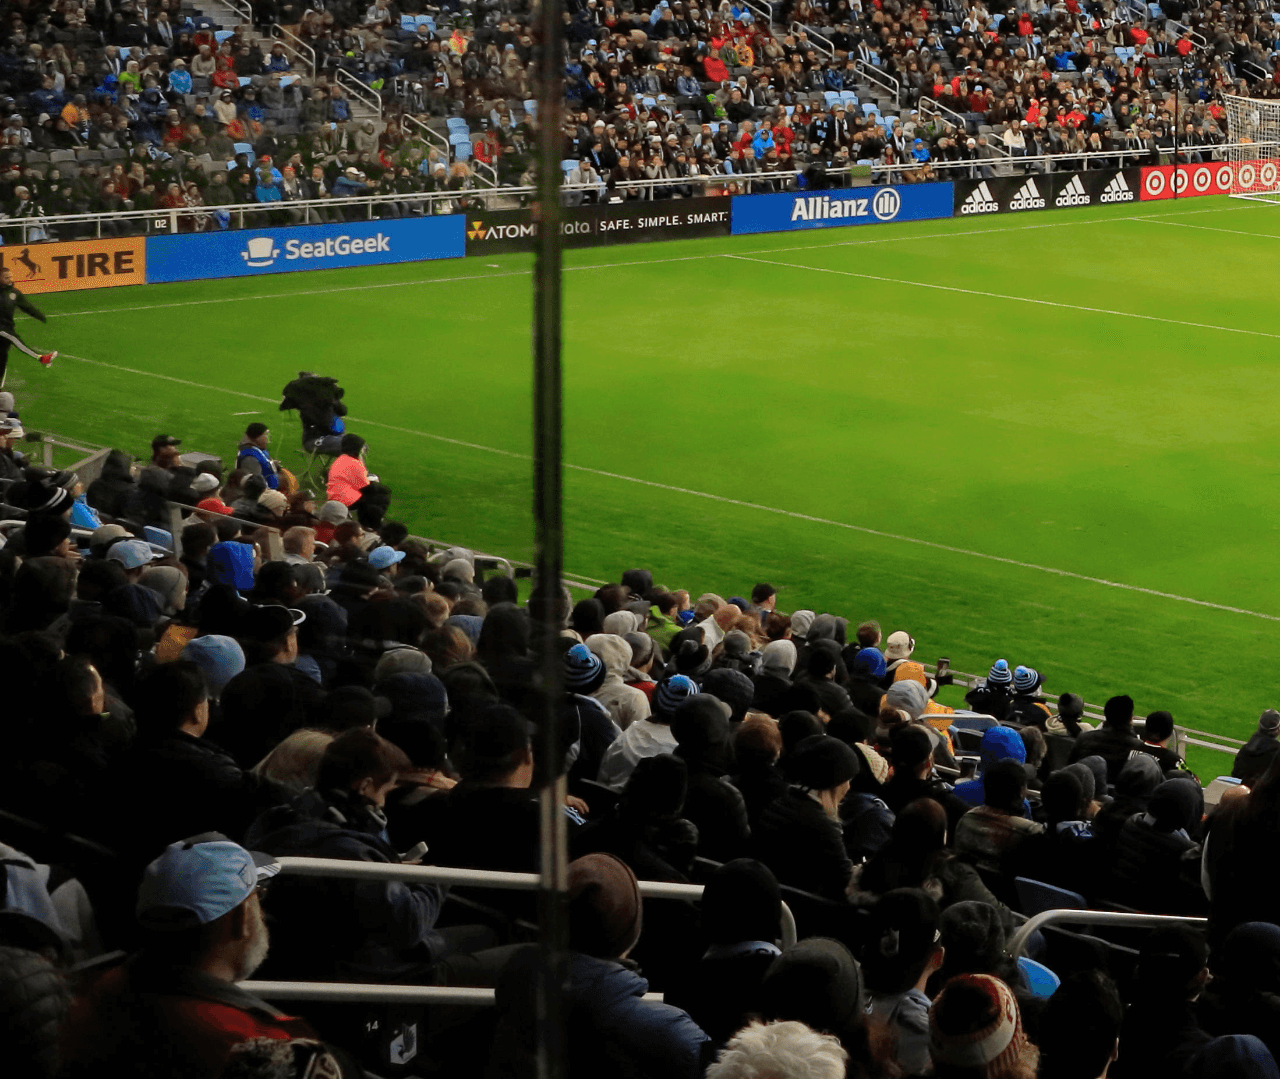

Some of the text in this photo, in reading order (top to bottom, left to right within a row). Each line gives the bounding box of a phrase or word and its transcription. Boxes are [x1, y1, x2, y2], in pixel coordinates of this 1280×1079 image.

[1009, 196, 1046, 210] adidas
[1055, 193, 1091, 207] adidas
[1100, 189, 1134, 203] adidas
[791, 196, 869, 221] Allianz
[961, 201, 999, 215] adidas
[600, 218, 633, 232] SAFE.
[638, 215, 683, 229] SIMPLE.
[285, 232, 391, 260] SeatGeek
[51, 250, 134, 279] TIRE
[365, 1020, 379, 1032] 14
